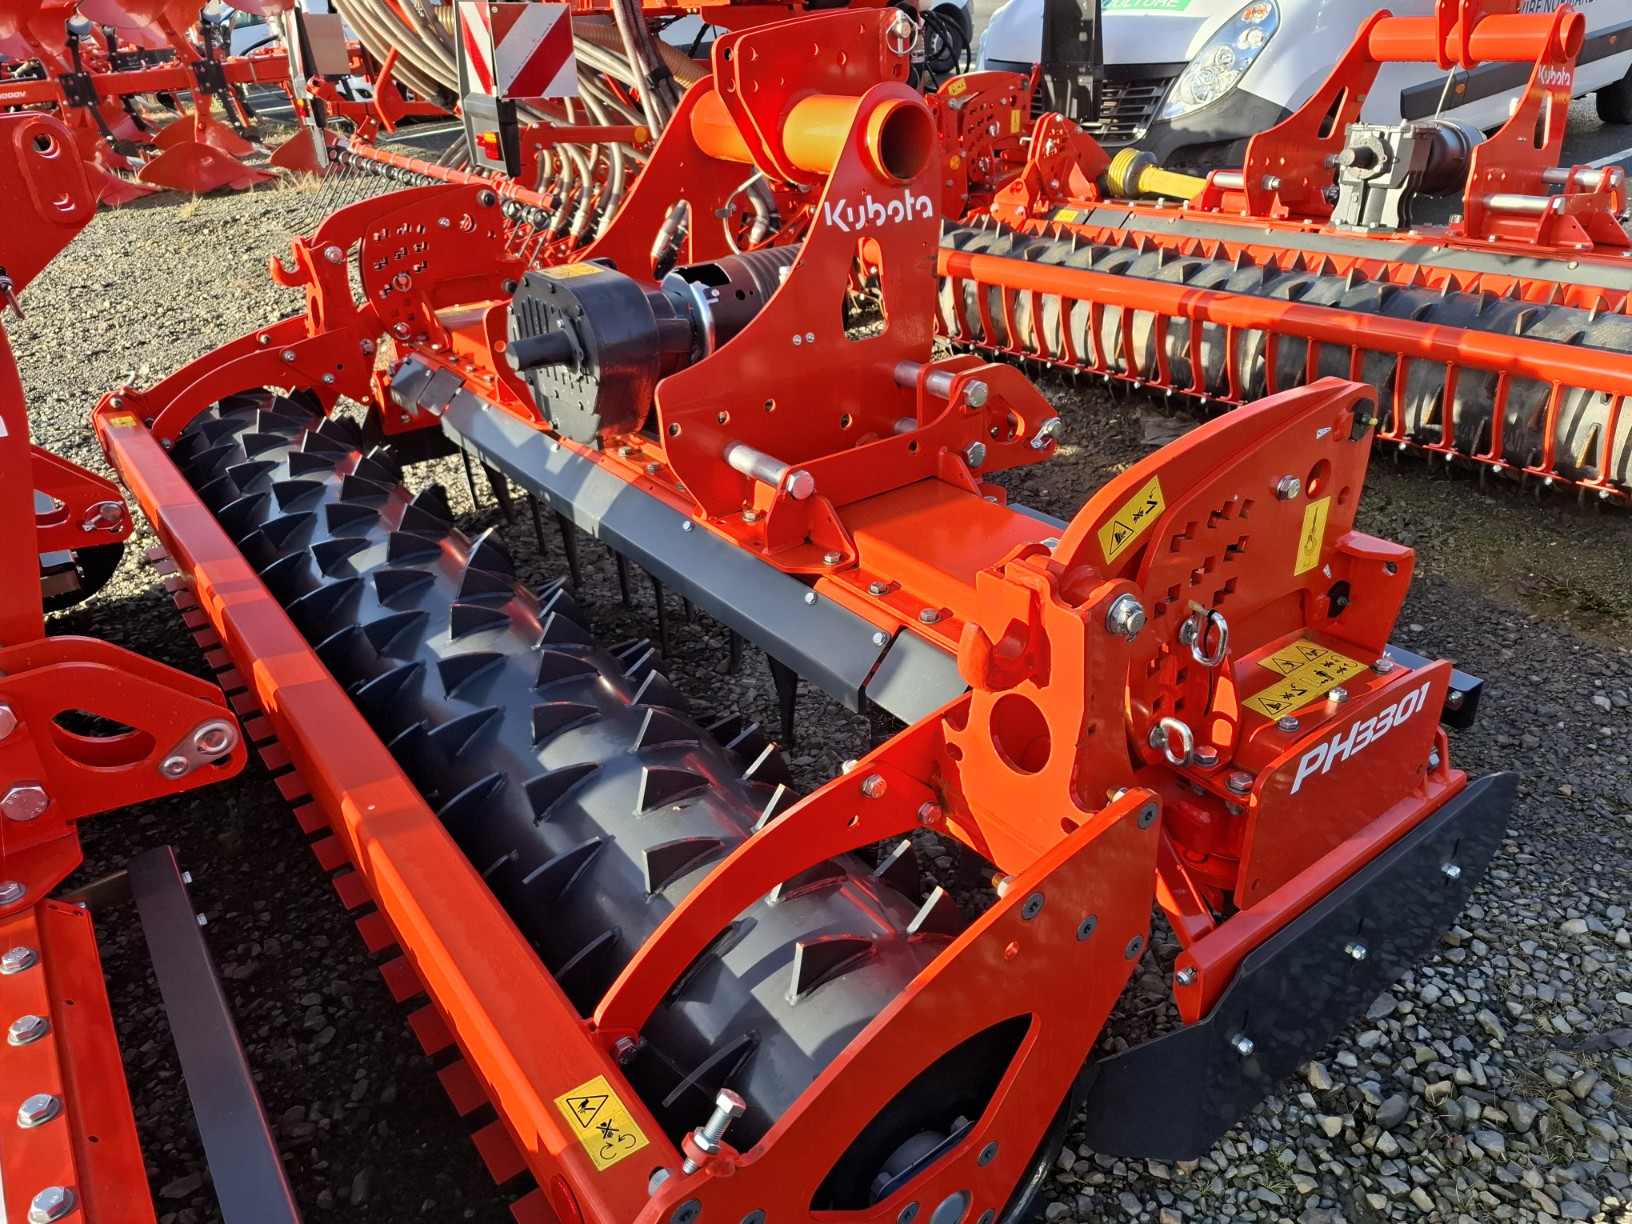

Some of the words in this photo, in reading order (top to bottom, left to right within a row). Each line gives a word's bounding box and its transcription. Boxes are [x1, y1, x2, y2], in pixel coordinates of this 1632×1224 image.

[1538, 65, 1571, 86] Kubota
[824, 189, 933, 232] Kubota
[1290, 681, 1431, 795] PH3301
